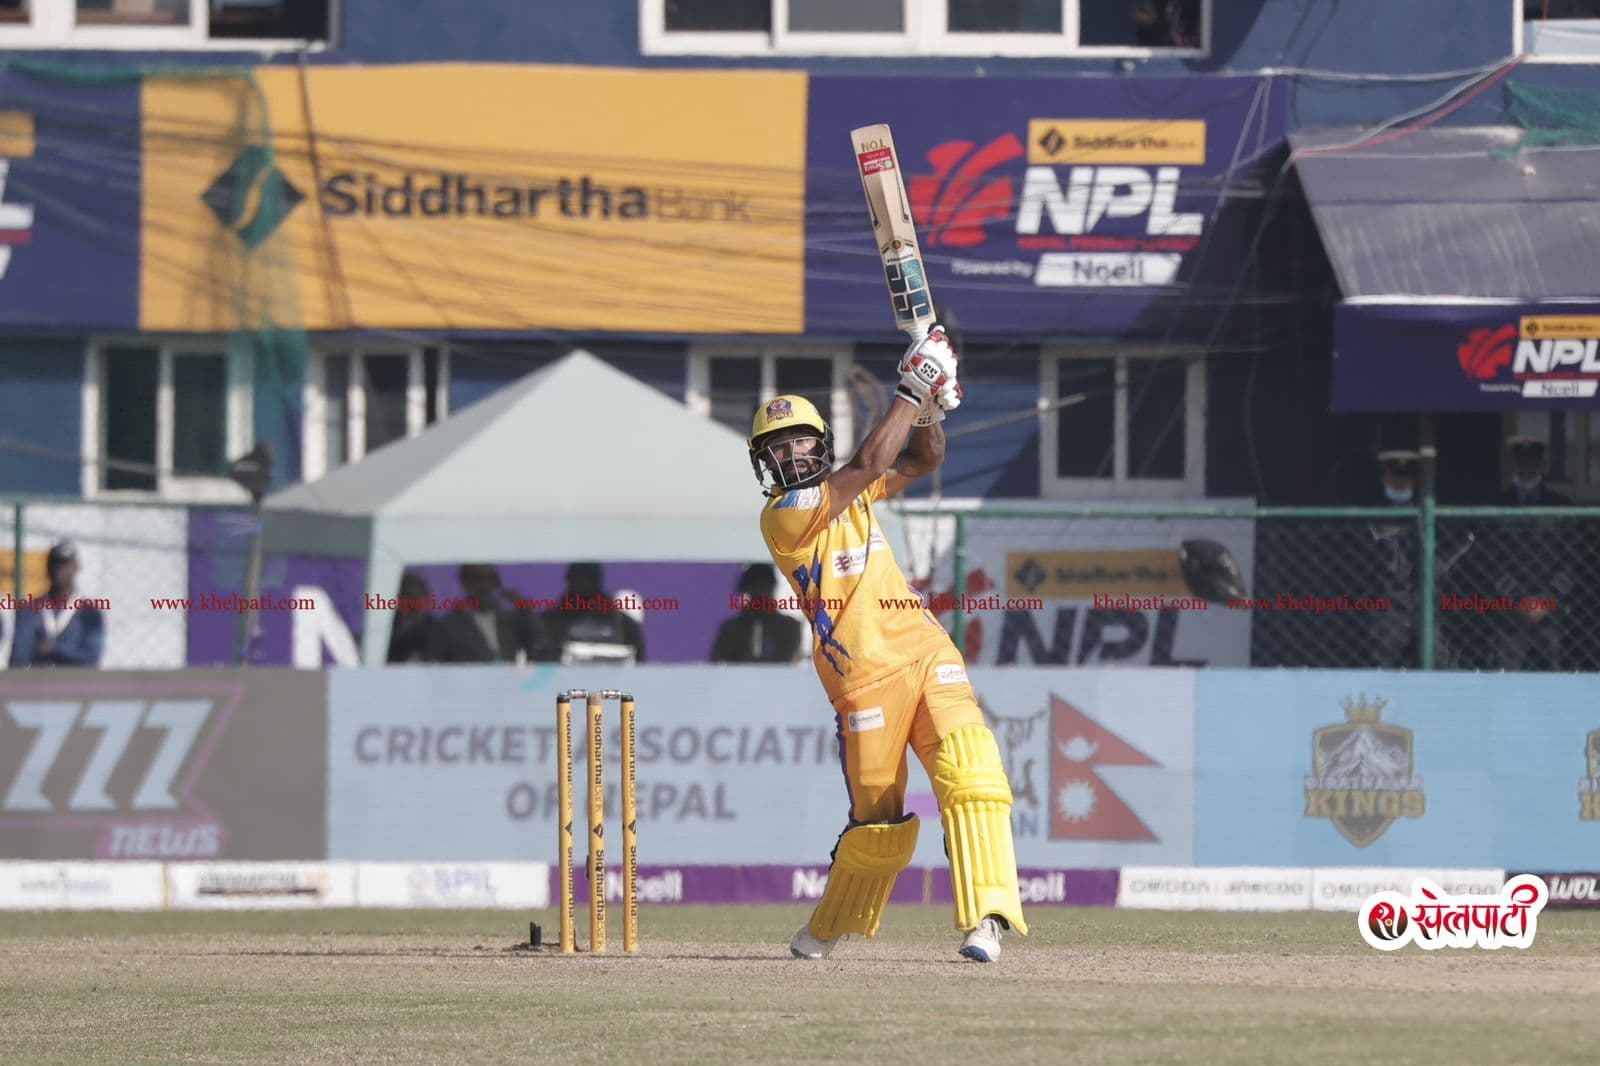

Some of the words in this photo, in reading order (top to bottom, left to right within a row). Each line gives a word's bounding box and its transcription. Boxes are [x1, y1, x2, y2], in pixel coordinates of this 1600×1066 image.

[323, 171, 651, 219] Siddhartha
[1015, 166, 1204, 236] NPL
[1512, 338, 1600, 373] NPL
[996, 607, 1209, 666] NPL
[354, 725, 559, 764] CRICKET
[1303, 789, 1425, 818] KINGS
